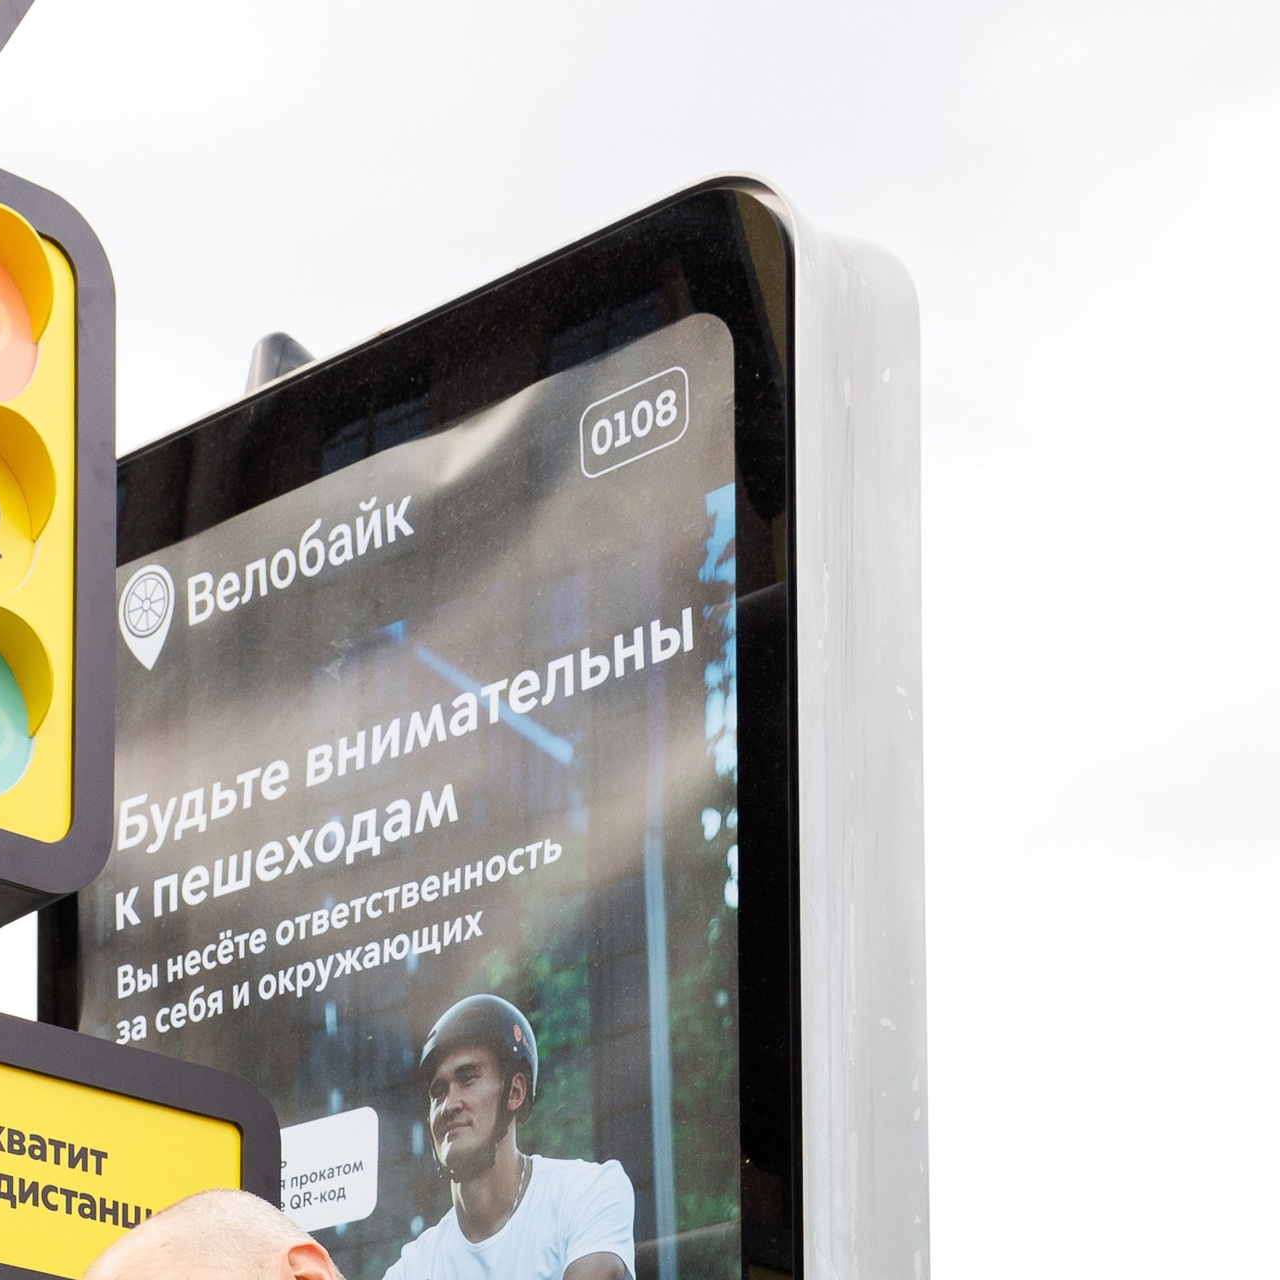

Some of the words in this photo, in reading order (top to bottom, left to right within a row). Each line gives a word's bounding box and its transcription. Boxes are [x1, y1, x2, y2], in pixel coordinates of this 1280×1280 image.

[591, 389, 677, 457] 0108
[187, 496, 414, 625] Велобайк
[117, 756, 291, 854] Будьте
[306, 607, 695, 786] внимательны
[116, 890, 141, 931] к
[152, 783, 458, 917] пешеходам
[117, 951, 158, 998] Вы
[166, 926, 267, 983] несёте
[276, 837, 562, 947] ответственность
[116, 1013, 147, 1045] за
[155, 983, 224, 1033] себя
[233, 986, 249, 1011] и
[258, 912, 484, 1002] окружающих
[290, 1160, 363, 1189] прокатом
[290, 1187, 346, 1211] QR-код
